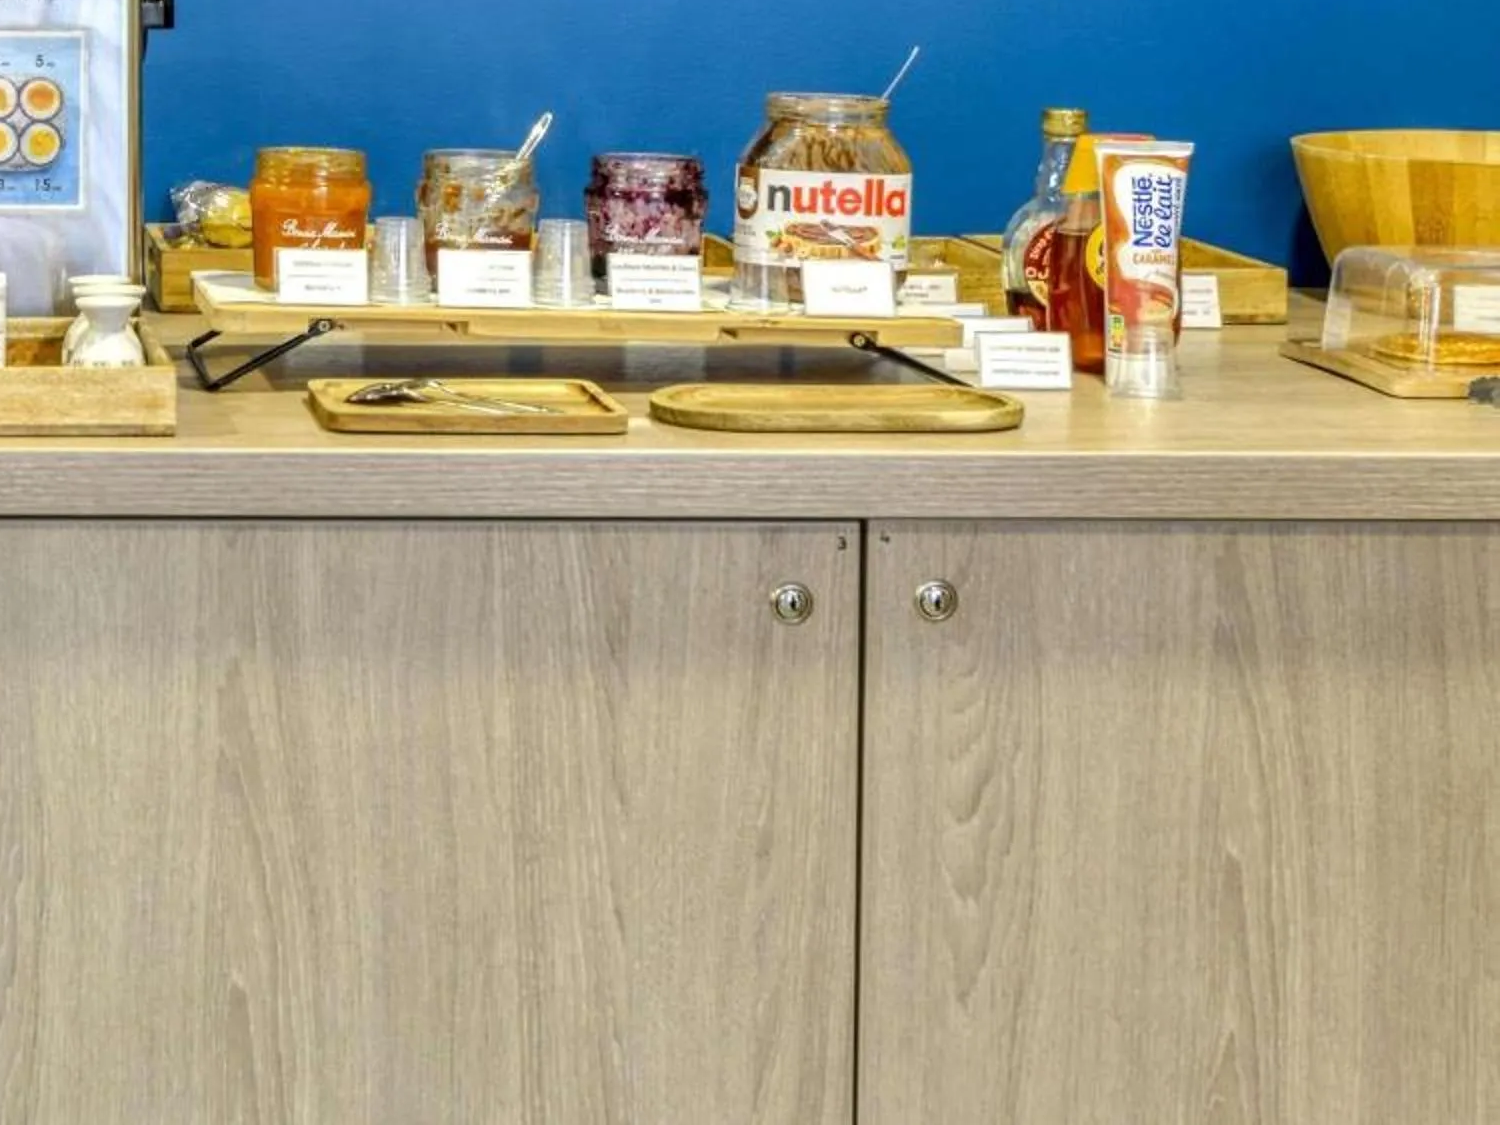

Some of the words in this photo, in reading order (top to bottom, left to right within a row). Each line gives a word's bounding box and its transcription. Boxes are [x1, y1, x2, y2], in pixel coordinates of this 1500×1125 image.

[35, 54, 45, 68] 5
[35, 178, 51, 192] 15
[766, 178, 907, 217] nutella
[1153, 173, 1173, 220] lait
